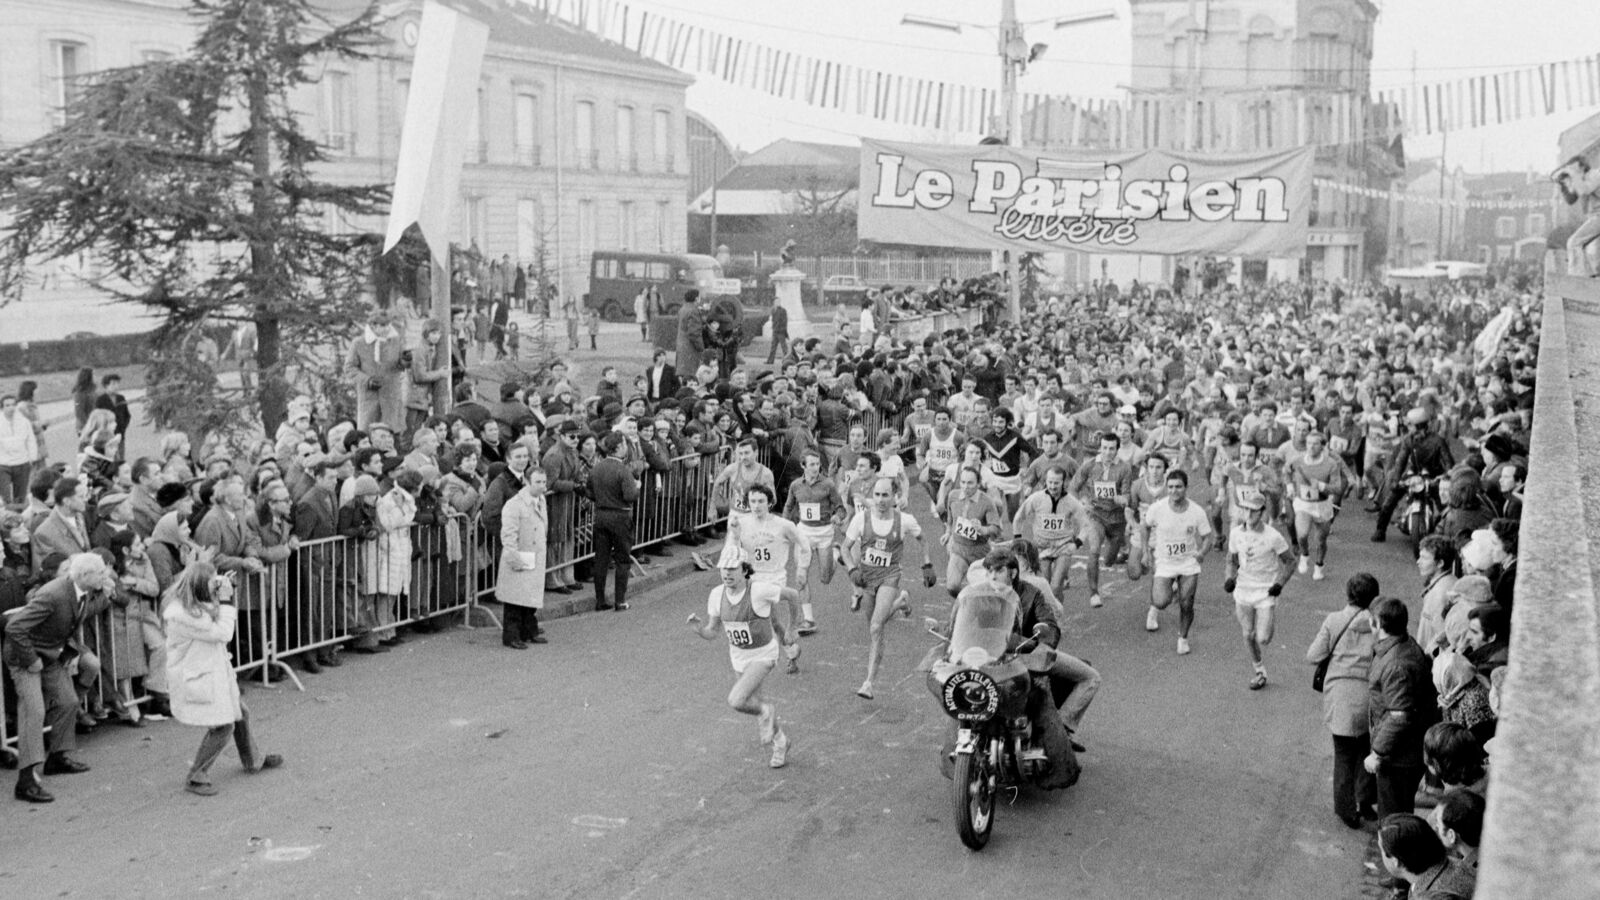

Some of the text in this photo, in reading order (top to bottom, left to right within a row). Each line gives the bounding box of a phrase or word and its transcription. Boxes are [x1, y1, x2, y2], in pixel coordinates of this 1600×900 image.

[872, 153, 1289, 222] Le Parisien
[995, 203, 1140, 245] libéré
[936, 449, 952, 459] 389
[1096, 486, 1115, 498] 238
[806, 508, 813, 520] 6
[956, 523, 976, 539] 242
[1043, 519, 1063, 530] 267
[755, 548, 771, 561] 35
[1166, 543, 1186, 556] 328
[969, 671, 999, 713] TELEVISEES
